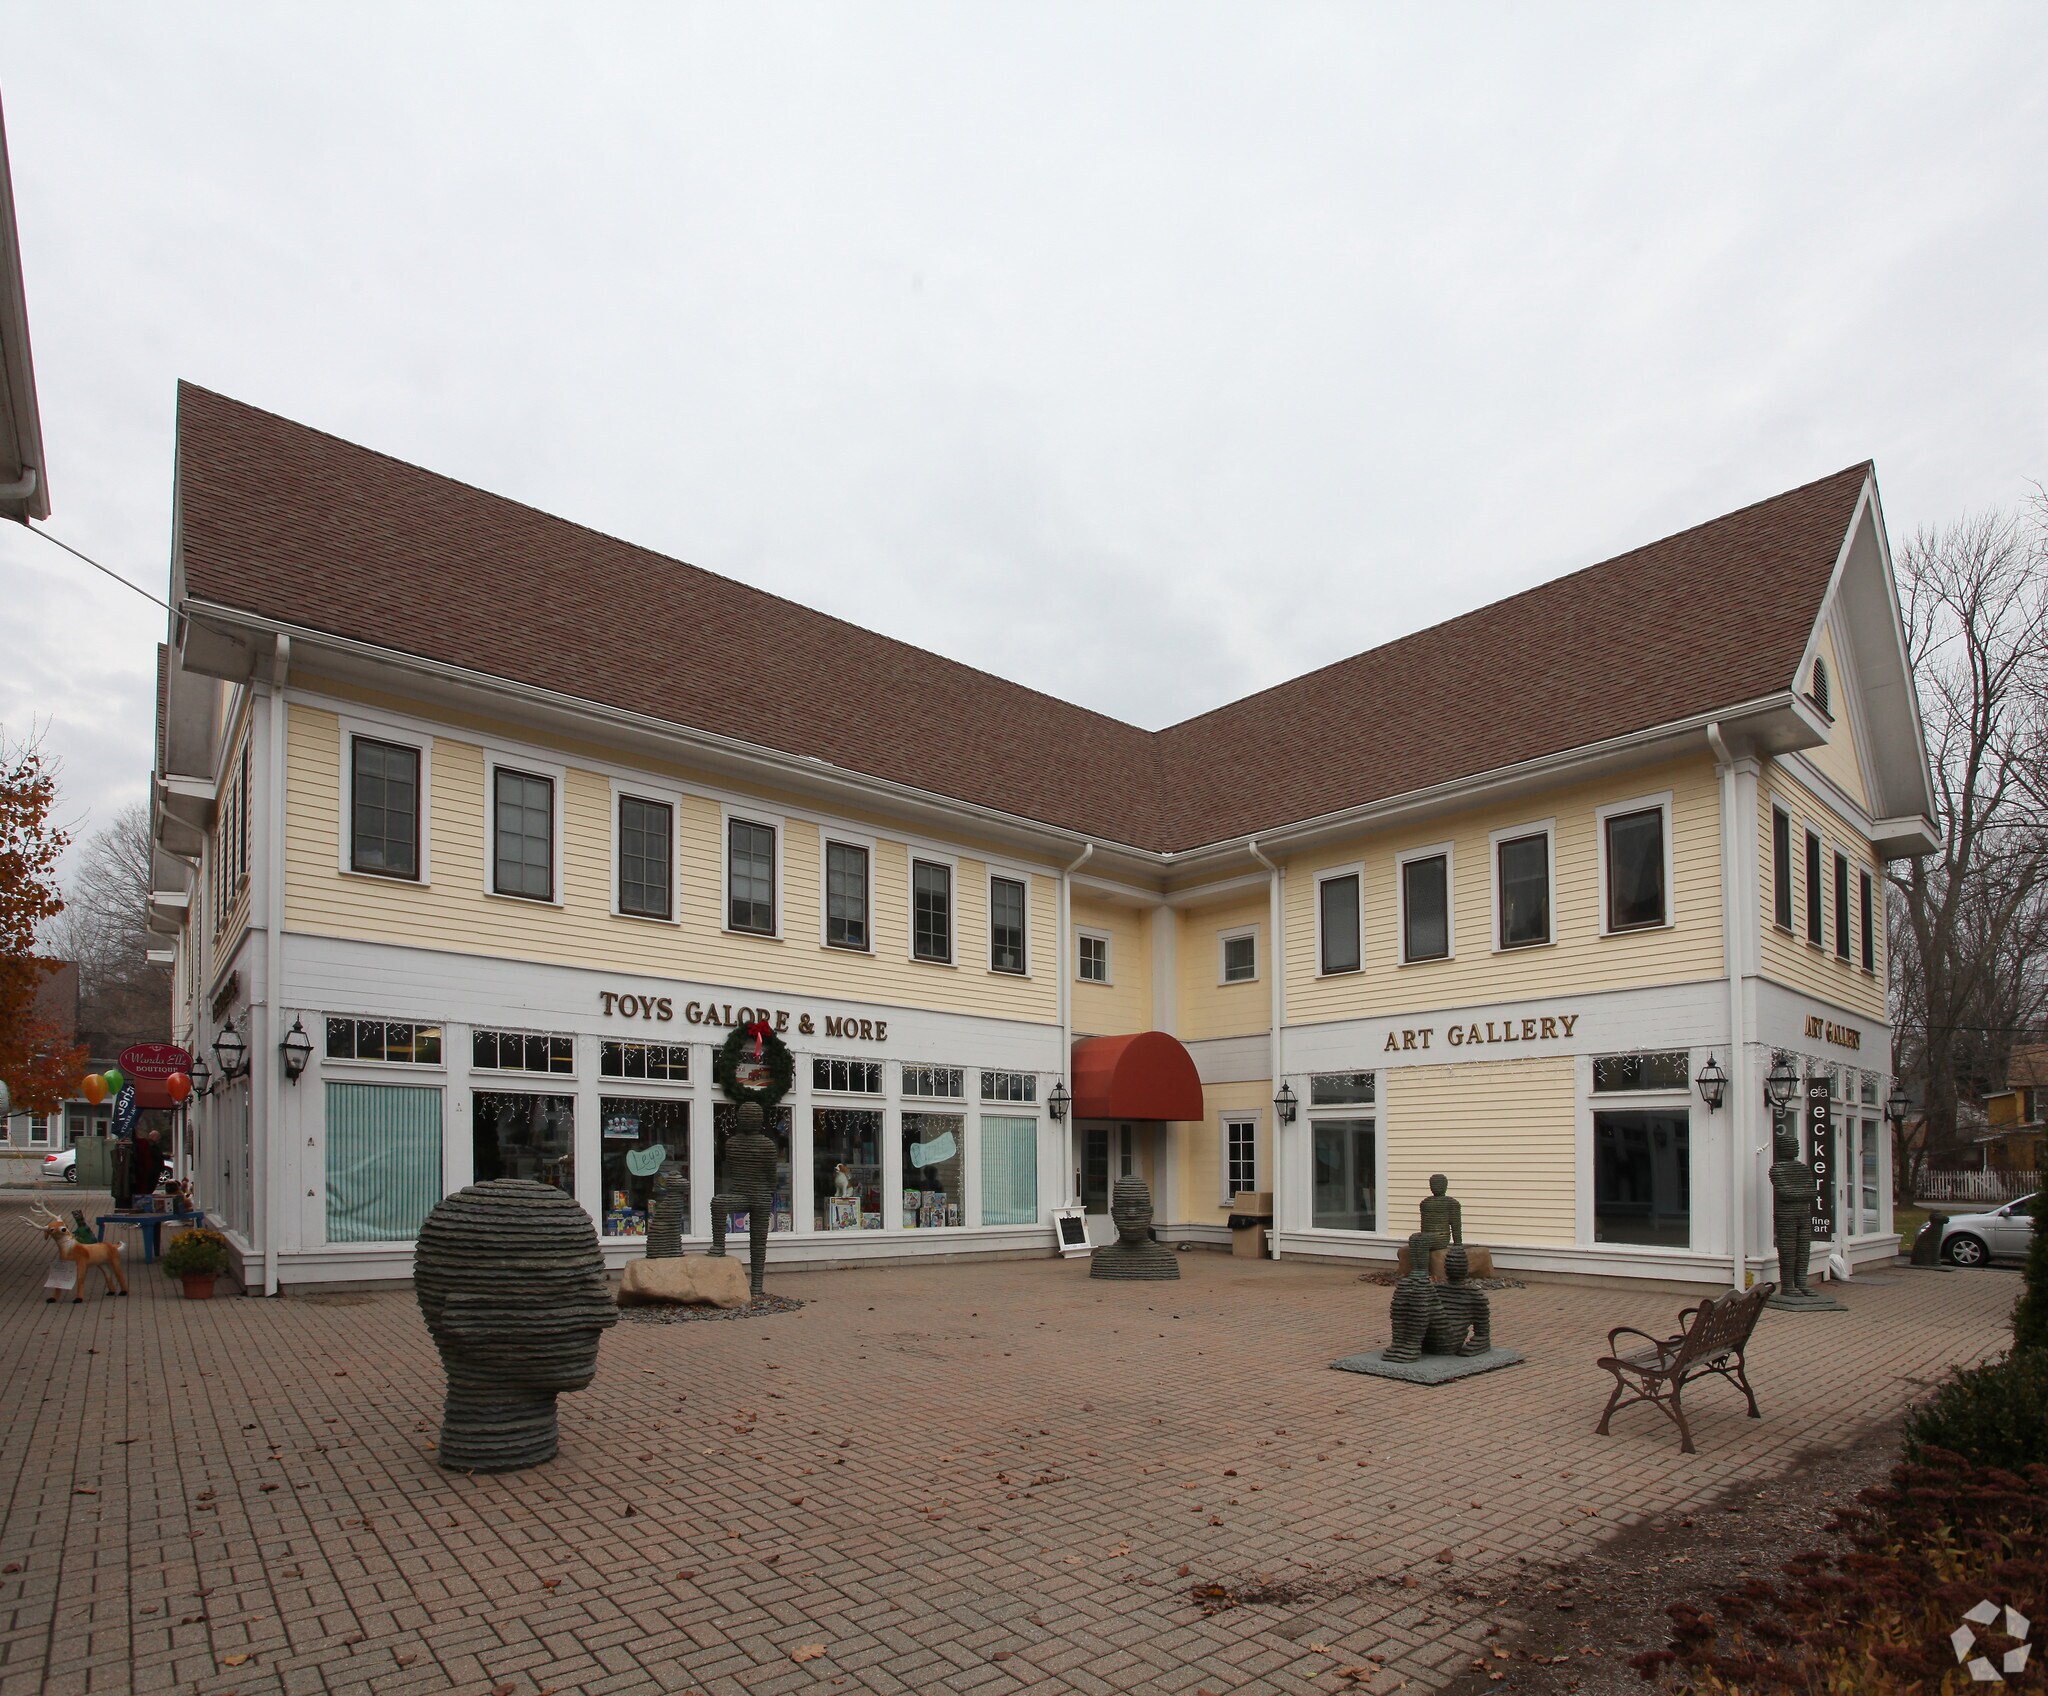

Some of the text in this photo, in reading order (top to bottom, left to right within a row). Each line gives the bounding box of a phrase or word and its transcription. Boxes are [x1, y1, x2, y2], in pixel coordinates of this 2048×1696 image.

[600, 991, 673, 1021] TOYS
[798, 1013, 815, 1035] &
[825, 1015, 888, 1041] MORE
[1804, 1014, 1824, 1040] ART
[1384, 1014, 1579, 1051] ART GALLERY
[125, 1052, 187, 1065] Wanda Elle
[1814, 1106, 1826, 1210] eckert
[1811, 1216, 1830, 1226] fine
[1813, 1225, 1828, 1233] art
